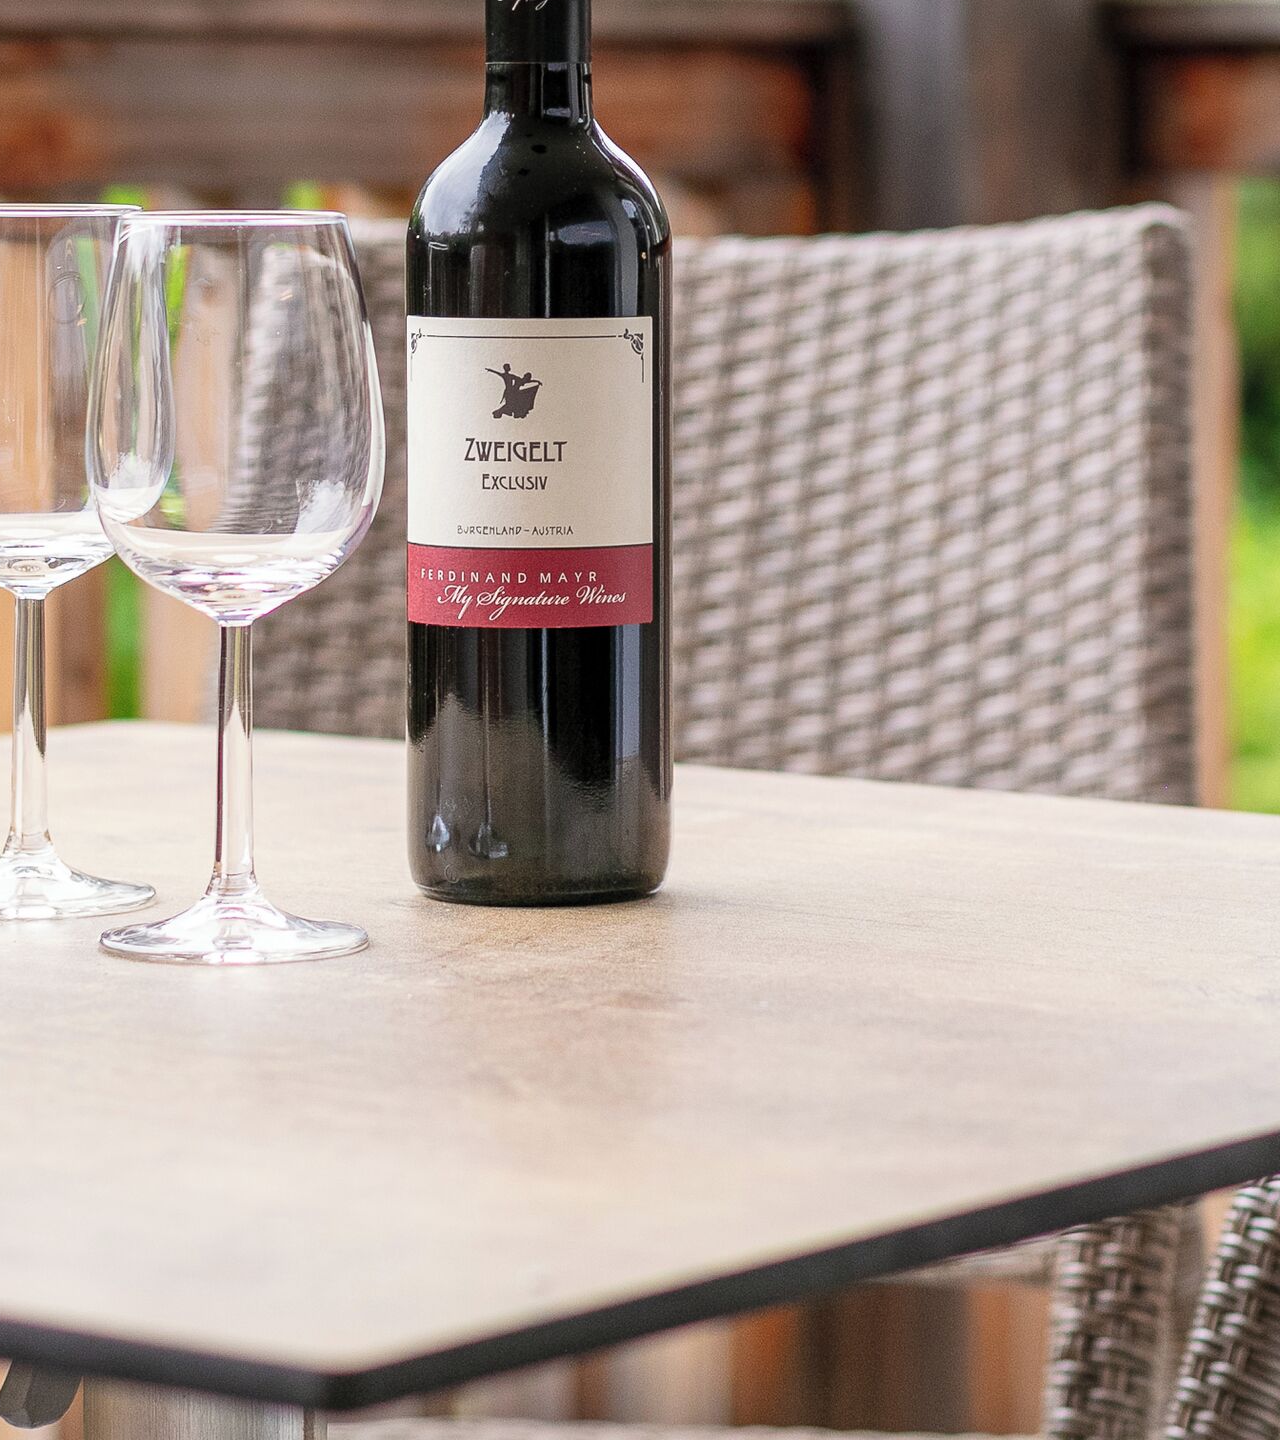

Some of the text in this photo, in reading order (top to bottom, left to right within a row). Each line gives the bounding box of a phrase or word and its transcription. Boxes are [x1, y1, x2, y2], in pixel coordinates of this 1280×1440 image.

[464, 437, 567, 462] ZWEIGELT
[482, 473, 548, 491] EXCLUSIV
[457, 524, 522, 536] BURGENLAND
[531, 525, 574, 536] AUSTRIA
[421, 568, 598, 584] FERDINAND MAYR
[437, 584, 626, 621] My Signature Wines
